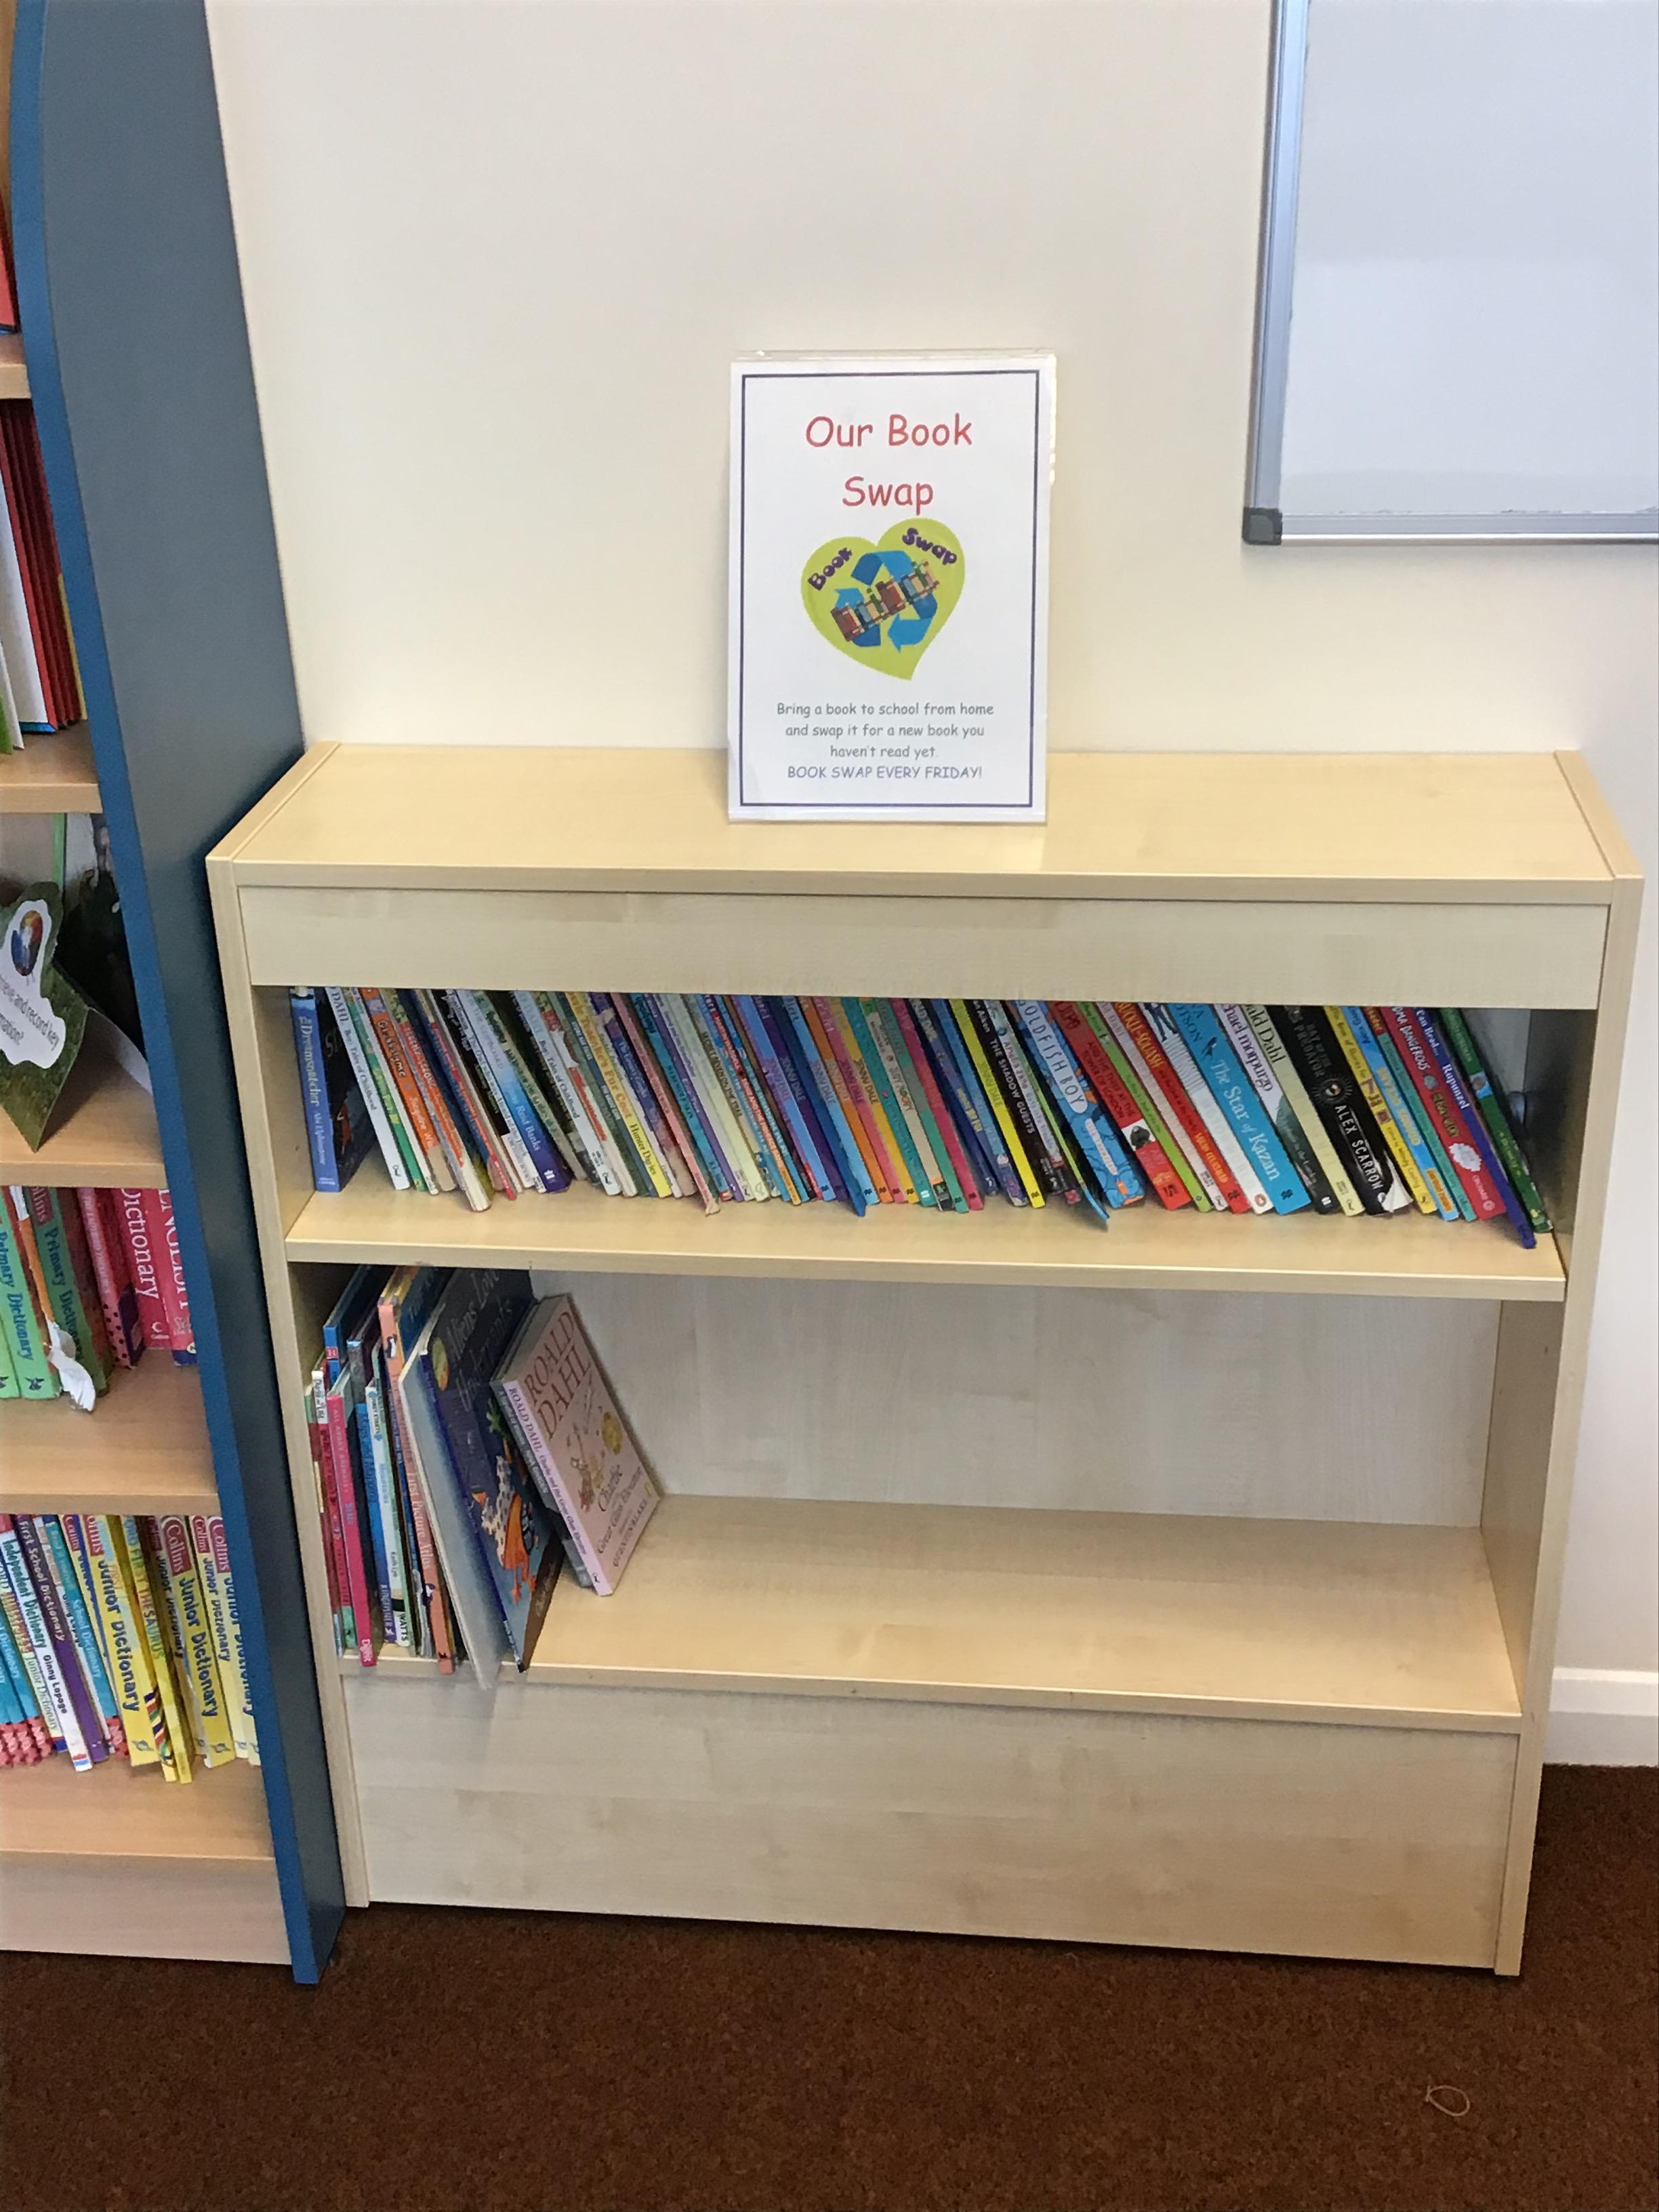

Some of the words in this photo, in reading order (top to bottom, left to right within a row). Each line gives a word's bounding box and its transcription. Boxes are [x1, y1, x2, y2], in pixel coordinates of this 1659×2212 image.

[806, 416, 873, 447] Our
[888, 413, 973, 447] Book
[842, 476, 934, 515] Swap
[901, 527, 958, 567] Swap
[807, 547, 854, 591] Book
[777, 703, 811, 718] Bring
[815, 707, 822, 715] a
[826, 703, 857, 715] book
[861, 704, 874, 715] to
[879, 703, 919, 715] school
[924, 703, 956, 715] from
[960, 703, 994, 715] home
[785, 724, 808, 736] and
[813, 726, 843, 739] swap
[848, 725, 857, 736] it
[863, 724, 883, 736] for
[887, 728, 895, 736] a
[899, 728, 923, 736] new
[928, 724, 958, 736] book
[962, 727, 984, 739] you
[830, 745, 876, 757] haven't
[881, 745, 909, 757] read
[787, 766, 827, 779] BOOK
[832, 766, 872, 779] SWAP
[877, 766, 920, 779] EVERY
[925, 766, 982, 779] FRIDAY!
[330, 991, 349, 1023] DAHL
[448, 991, 470, 1030] Tomlinson
[977, 1008, 992, 1033] Aiken
[1414, 1008, 1429, 1026] Can
[26, 1006, 51, 1036] record
[47, 1022, 60, 1051] key
[1258, 1026, 1287, 1064] Dahl
[1399, 1023, 1432, 1071] DANGEROUS
[299, 1023, 325, 1107] Dreamsnatcher
[349, 1046, 360, 1064] Tales
[355, 1065, 364, 1073] of
[546, 1056, 558, 1071] Tales
[1239, 1033, 1273, 1092] morpurgo
[1292, 1023, 1326, 1079] PREDATOR
[359, 1074, 377, 1111] Childhood
[552, 1071, 561, 1079] of
[792, 1082, 806, 1101] DALE
[853, 1057, 871, 1085] JENNY
[865, 1084, 880, 1105] DALE
[989, 1038, 1003, 1057] THE
[998, 1058, 1021, 1099] SHADOW
[1016, 1100, 1036, 1134] GUESTS
[1059, 1074, 1085, 1107] BOY
[1081, 1049, 1099, 1073] TOWER
[1094, 1073, 1106, 1086] OF
[1101, 1084, 1126, 1120] LONDON
[1086, 1040, 1101, 1059] AND
[1096, 1057, 1110, 1074] THE
[1123, 1103, 1136, 1118] THE
[1209, 1058, 1235, 1086] The
[1439, 1063, 1471, 1109] Rapunzel
[556, 1078, 580, 1119] Childhood
[579, 1014, 611, 1068] Teacake's
[605, 1069, 620, 1090] Fur
[615, 1091, 634, 1119] Coat
[628, 1122, 647, 1151] Hunter
[641, 1149, 659, 1176] Davies
[683, 1103, 695, 1119] SKIN
[822, 1085, 836, 1105] DALE
[1221, 1084, 1253, 1122] Star
[515, 1104, 531, 1126] Reid
[524, 1124, 542, 1151] Banks
[1239, 1119, 1256, 1134] of
[1333, 1102, 1358, 1135] ALEX
[1351, 1138, 1384, 1191] SCARROW
[1245, 1130, 1286, 1182] Kazan
[44, 1225, 66, 1287] Primary
[0, 1231, 14, 1288] Primary
[7, 1293, 33, 1360] Dictionary
[524, 1311, 576, 1403] ROALD
[539, 1345, 591, 1439] DAHL
[333, 1408, 341, 1422] ALL
[506, 1386, 531, 1423] ROALD
[523, 1422, 545, 1452] DAHL
[405, 1470, 421, 1498] First
[537, 1454, 553, 1476] Charlie
[548, 1475, 558, 1488] and
[554, 1487, 564, 1498] the
[193, 1517, 207, 1552] Collins
[411, 1498, 430, 1538] Picture
[133, 1549, 149, 1586] FIRST
[167, 1525, 185, 1574] Collins
[212, 1524, 229, 1572] Collins
[419, 1542, 436, 1570] Atlas
[3, 1540, 30, 1597] Independent
[24, 1595, 46, 1648] Dictionary
[18, 1520, 32, 1549] First
[28, 1549, 49, 1584] School
[41, 1584, 65, 1641] Dictionary
[138, 1586, 166, 1659] THESAURUS
[204, 1559, 218, 1595] Junior
[211, 1599, 230, 1662] Dictionary
[380, 1584, 392, 1627] KINGFISHER
[98, 1560, 121, 1617] Junior
[112, 1620, 140, 1712] Dictionary
[398, 1612, 409, 1641] WATTS
[43, 1655, 56, 1680] Ginny
[79, 1631, 101, 1679] Dictionary
[179, 1578, 200, 1627] Junior
[192, 1632, 218, 1717] Dictionary
[24, 1654, 43, 1687] Junior
[36, 1685, 57, 1729] Dictionary
